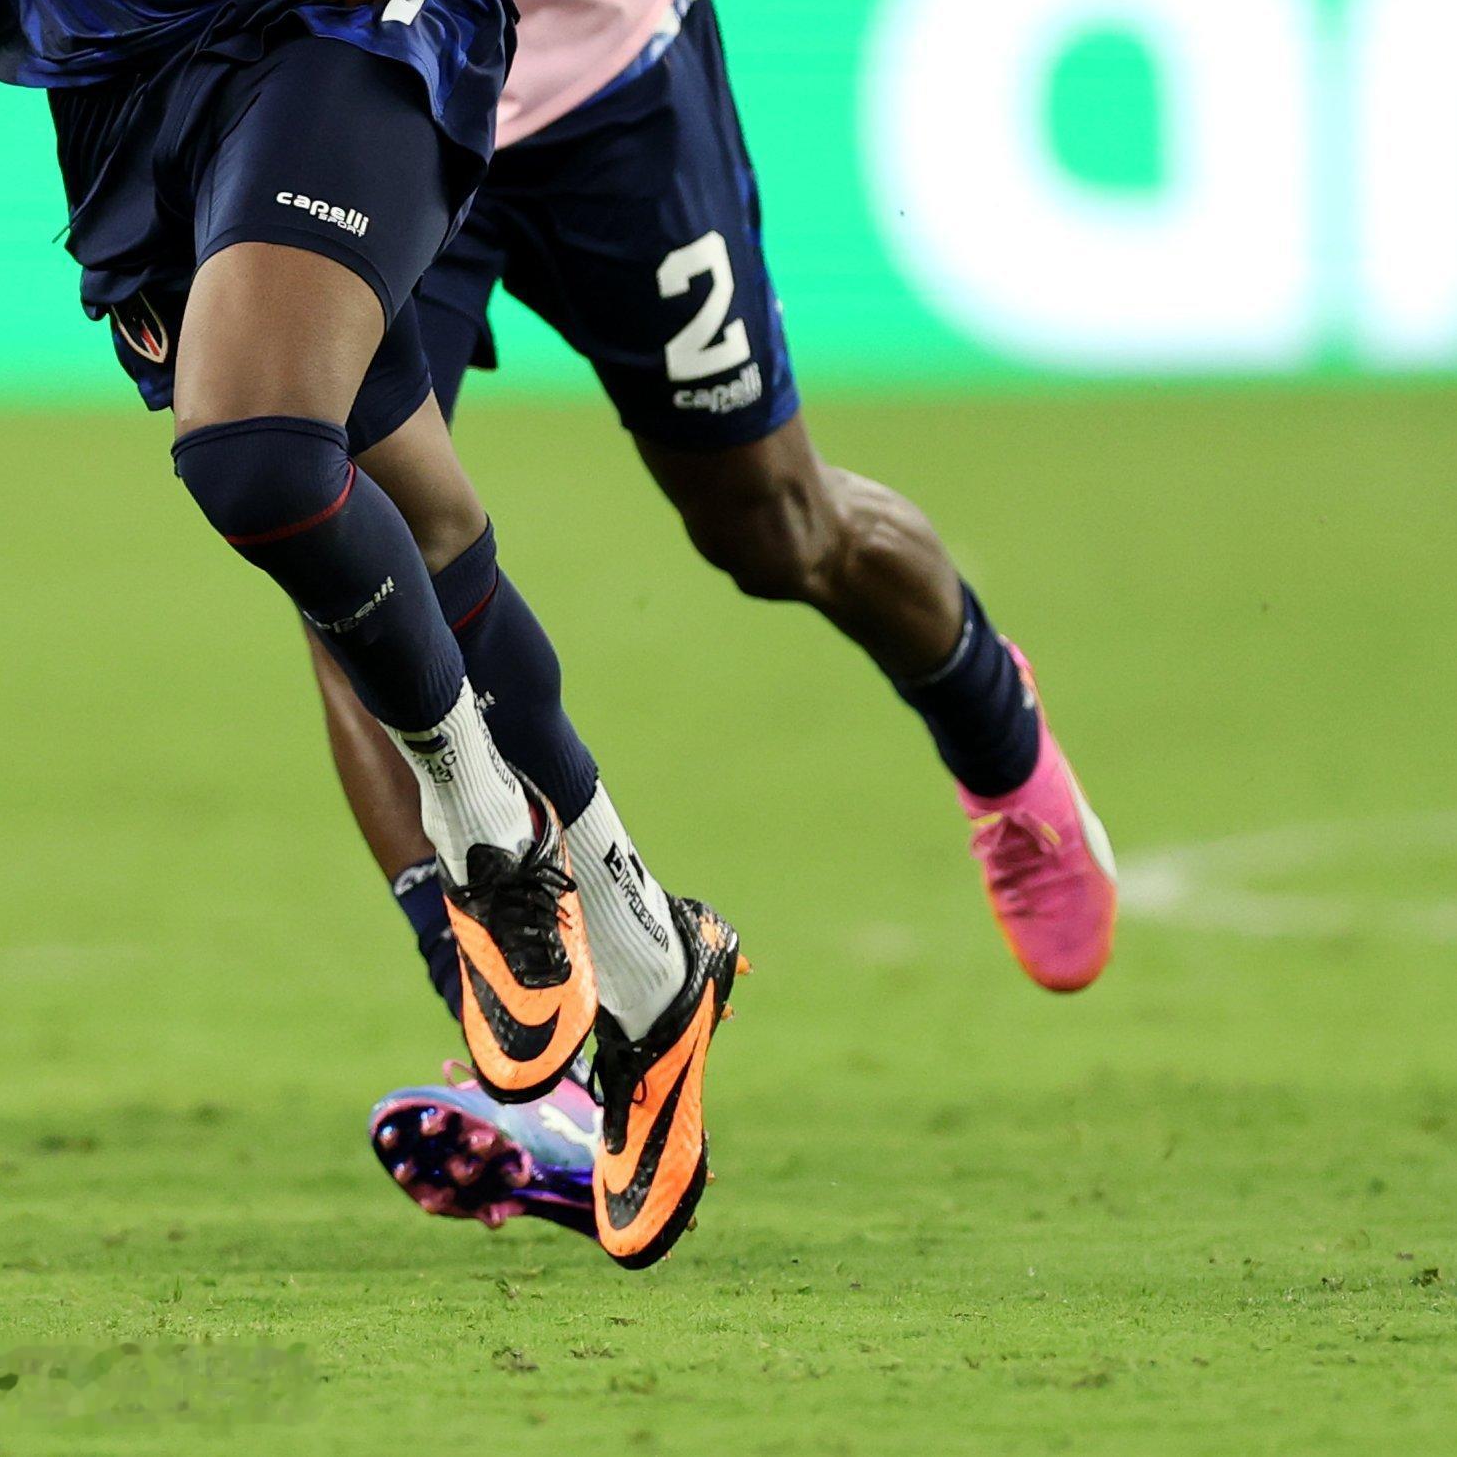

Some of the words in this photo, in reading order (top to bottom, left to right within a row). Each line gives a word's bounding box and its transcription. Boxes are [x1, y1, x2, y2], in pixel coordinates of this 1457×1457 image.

[276, 191, 370, 231] capelli
[318, 212, 365, 237] SPORT
[655, 229, 752, 382] 2
[619, 869, 670, 954] TAPEDESIGN
